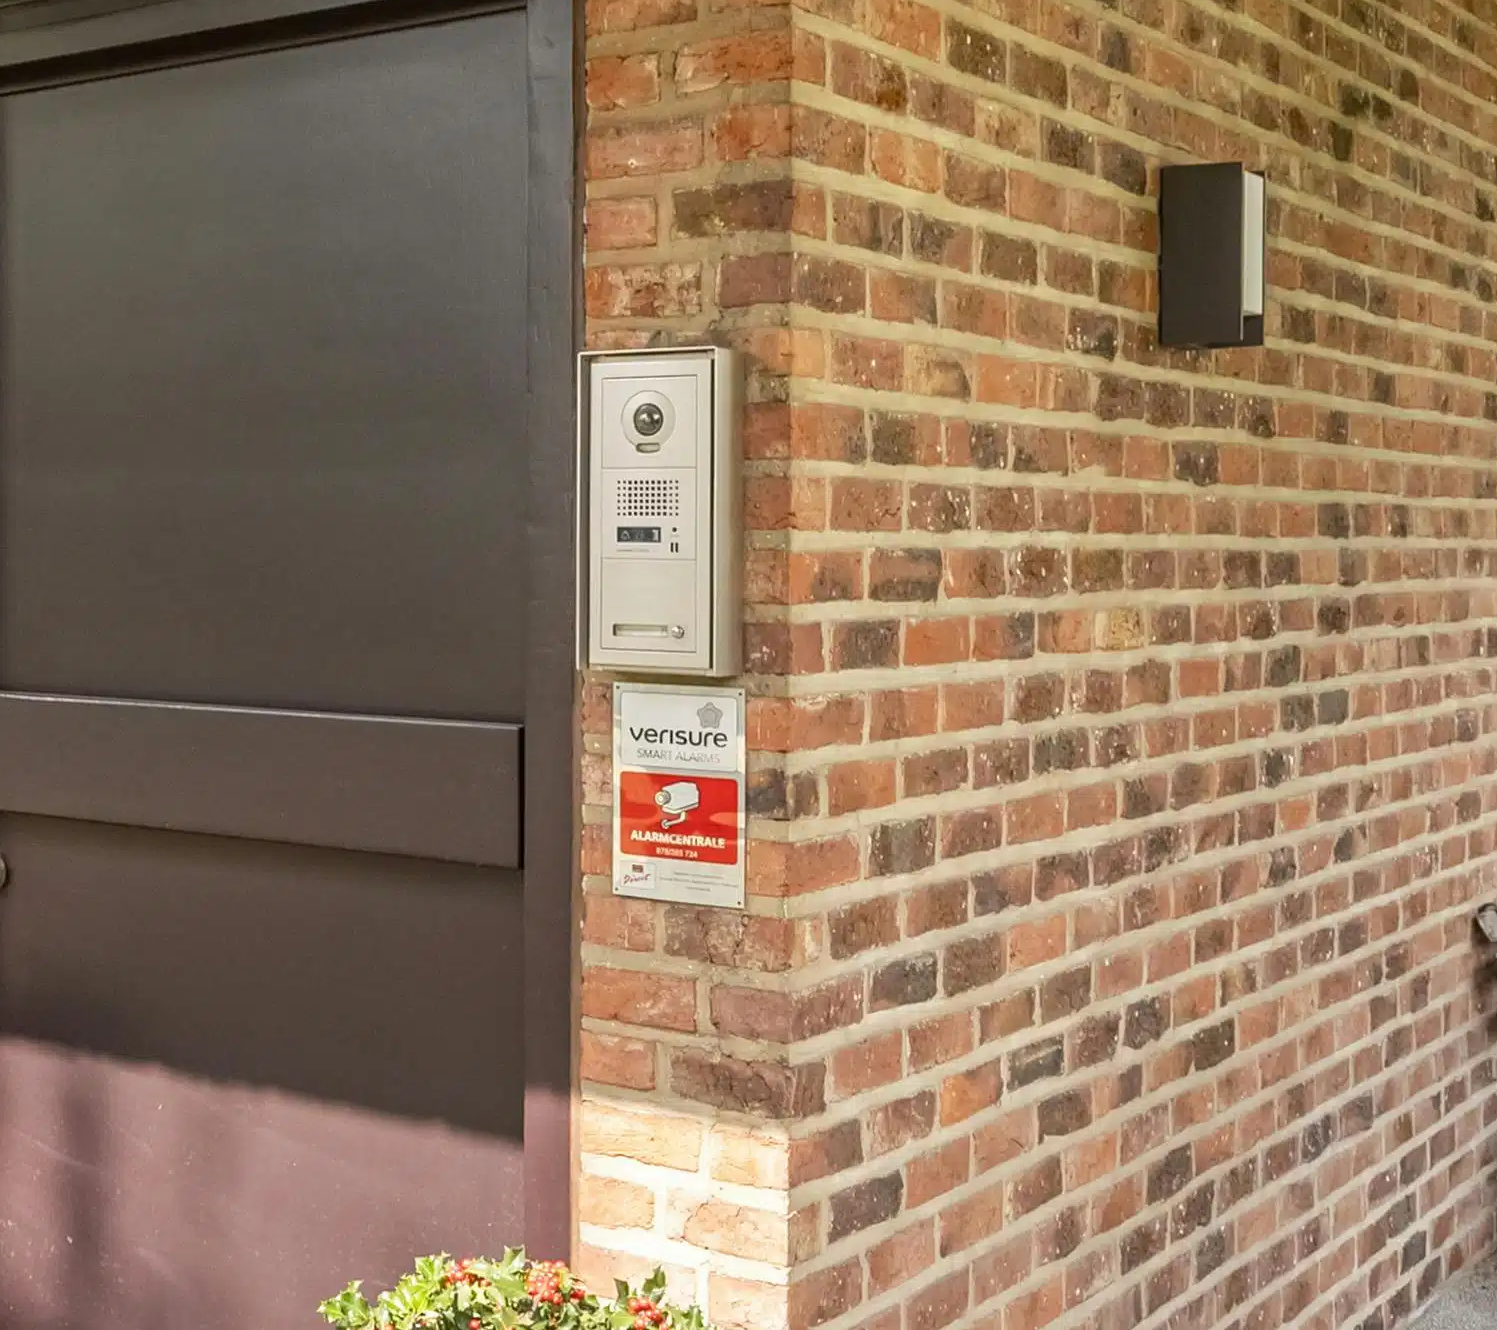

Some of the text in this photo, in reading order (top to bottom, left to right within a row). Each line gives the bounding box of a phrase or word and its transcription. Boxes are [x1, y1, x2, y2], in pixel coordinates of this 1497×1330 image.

[629, 726, 728, 748] verisure
[636, 748, 721, 763] SMART ALARMS
[630, 829, 726, 849] ALARMCENTRALE
